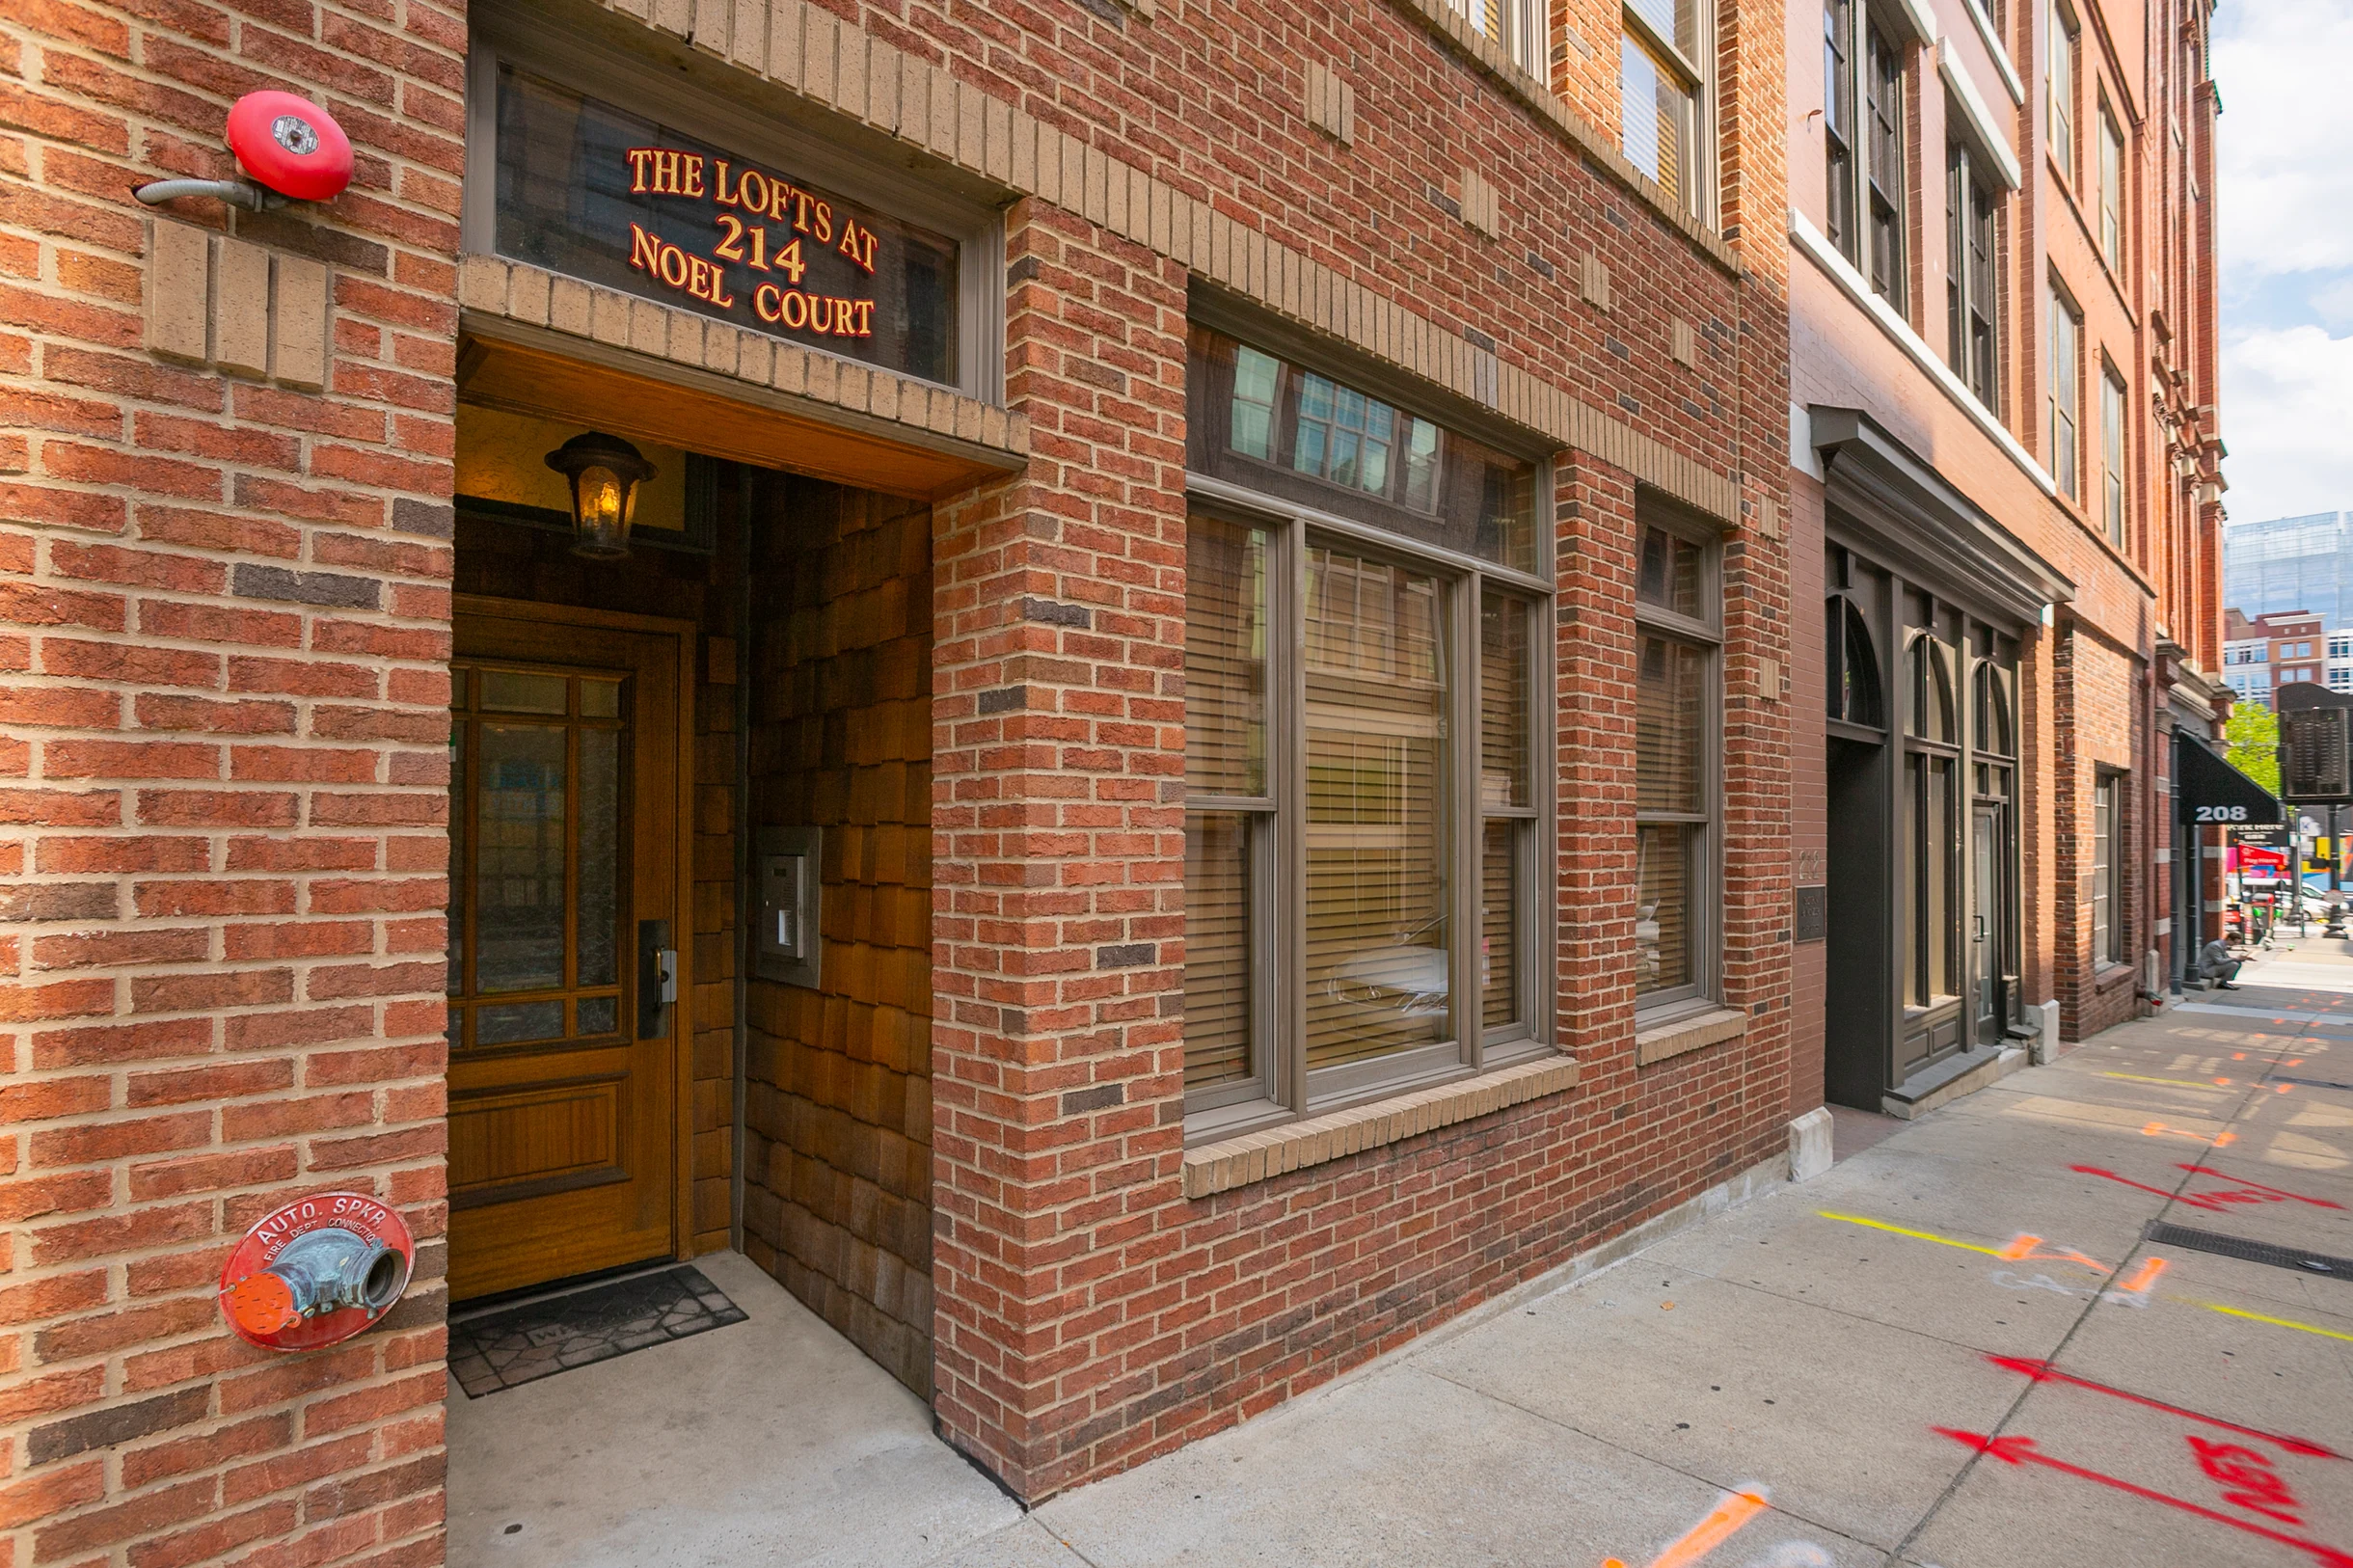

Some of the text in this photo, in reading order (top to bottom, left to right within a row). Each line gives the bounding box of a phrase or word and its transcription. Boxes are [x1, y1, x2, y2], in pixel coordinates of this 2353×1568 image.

[628, 148, 879, 273] THE LOFTS AT
[630, 223, 875, 337] NOEL COURT
[714, 213, 806, 284] 214
[2196, 805, 2248, 821] 208
[263, 1238, 286, 1261] FIRE
